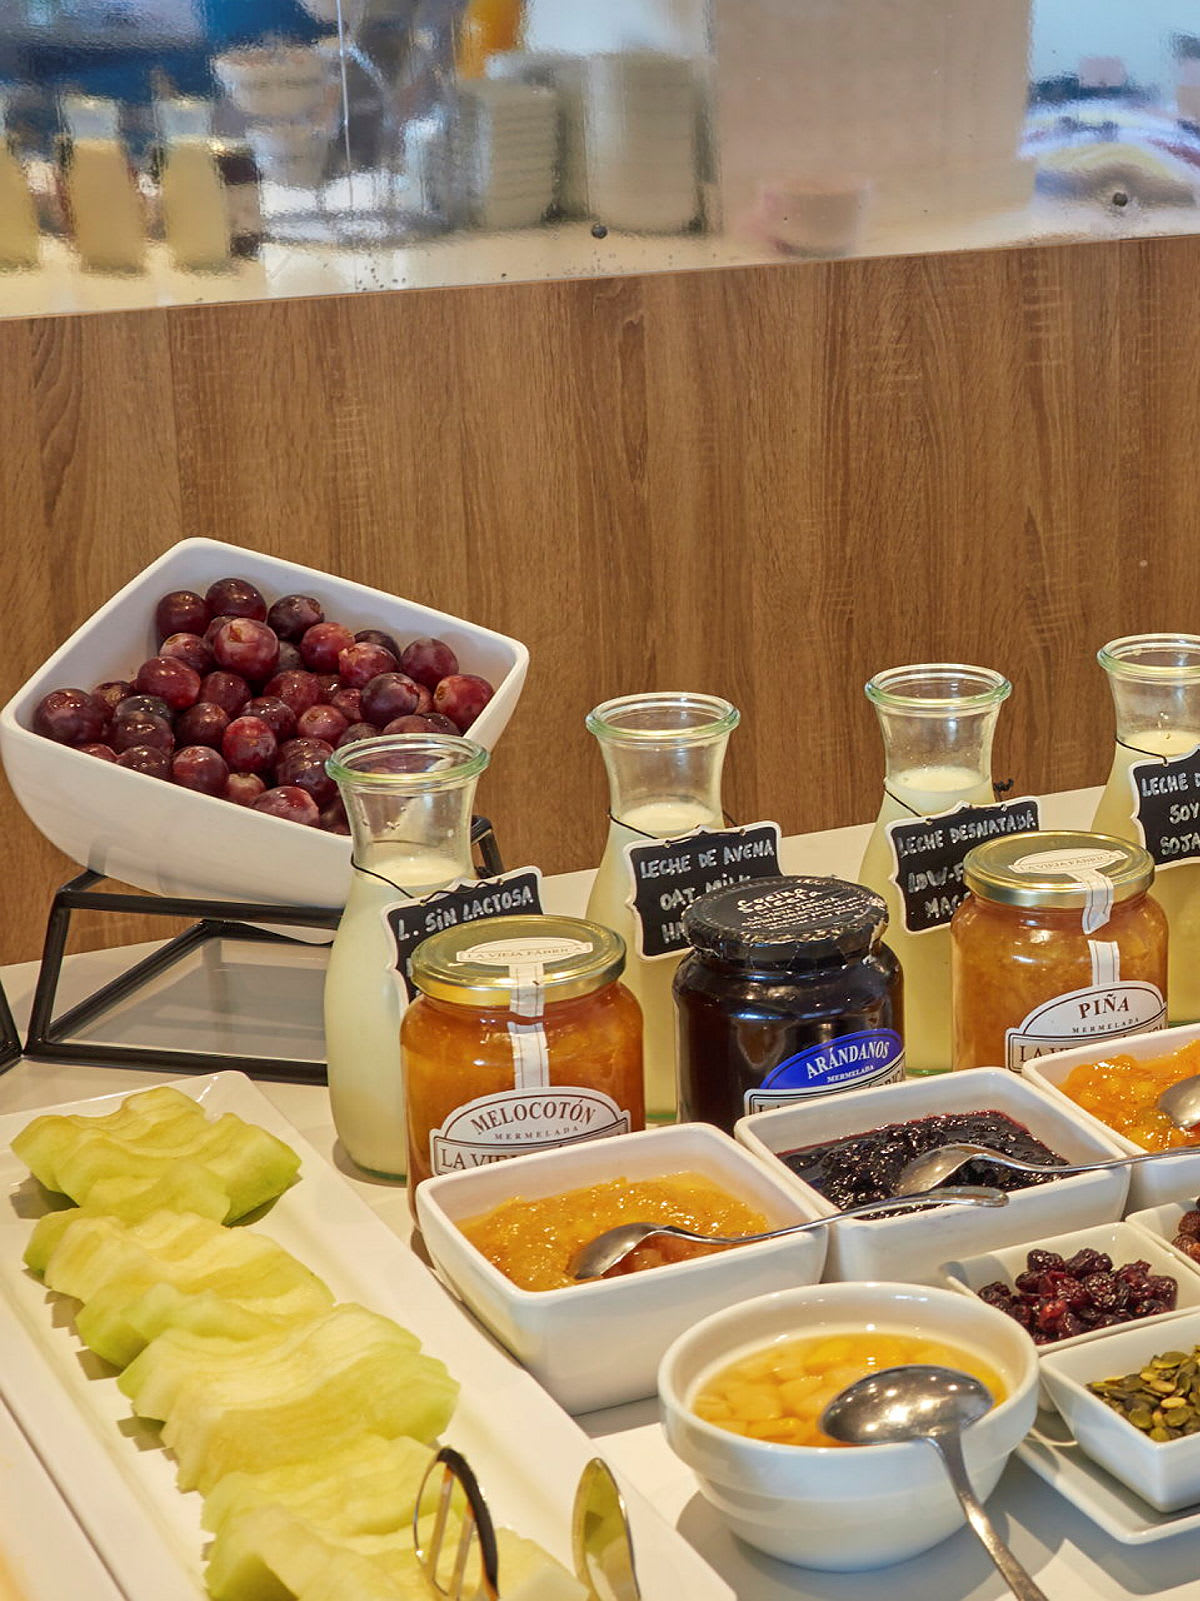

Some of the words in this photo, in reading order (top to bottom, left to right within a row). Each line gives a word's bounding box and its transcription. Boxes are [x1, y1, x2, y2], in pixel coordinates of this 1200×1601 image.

[1142, 772, 1189, 797] LECHE
[897, 829, 944, 859] LECHE
[949, 809, 1037, 844] DESNATADA
[639, 854, 692, 880] LECHE
[698, 848, 718, 868] DE
[722, 838, 775, 866] AVENA
[659, 887, 696, 911] OAT
[398, 918, 420, 941] L.
[463, 885, 534, 921] LACTOSA
[1078, 993, 1130, 1020] PIÑA
[1072, 1017, 1140, 1034] MERMELADA
[805, 1040, 891, 1080] ARÁNDANOS
[826, 1064, 875, 1084] MERMELADA
[470, 1099, 597, 1136] MELOCOTÓN
[494, 1125, 580, 1141] MERMELADA
[441, 1148, 467, 1170] LA
